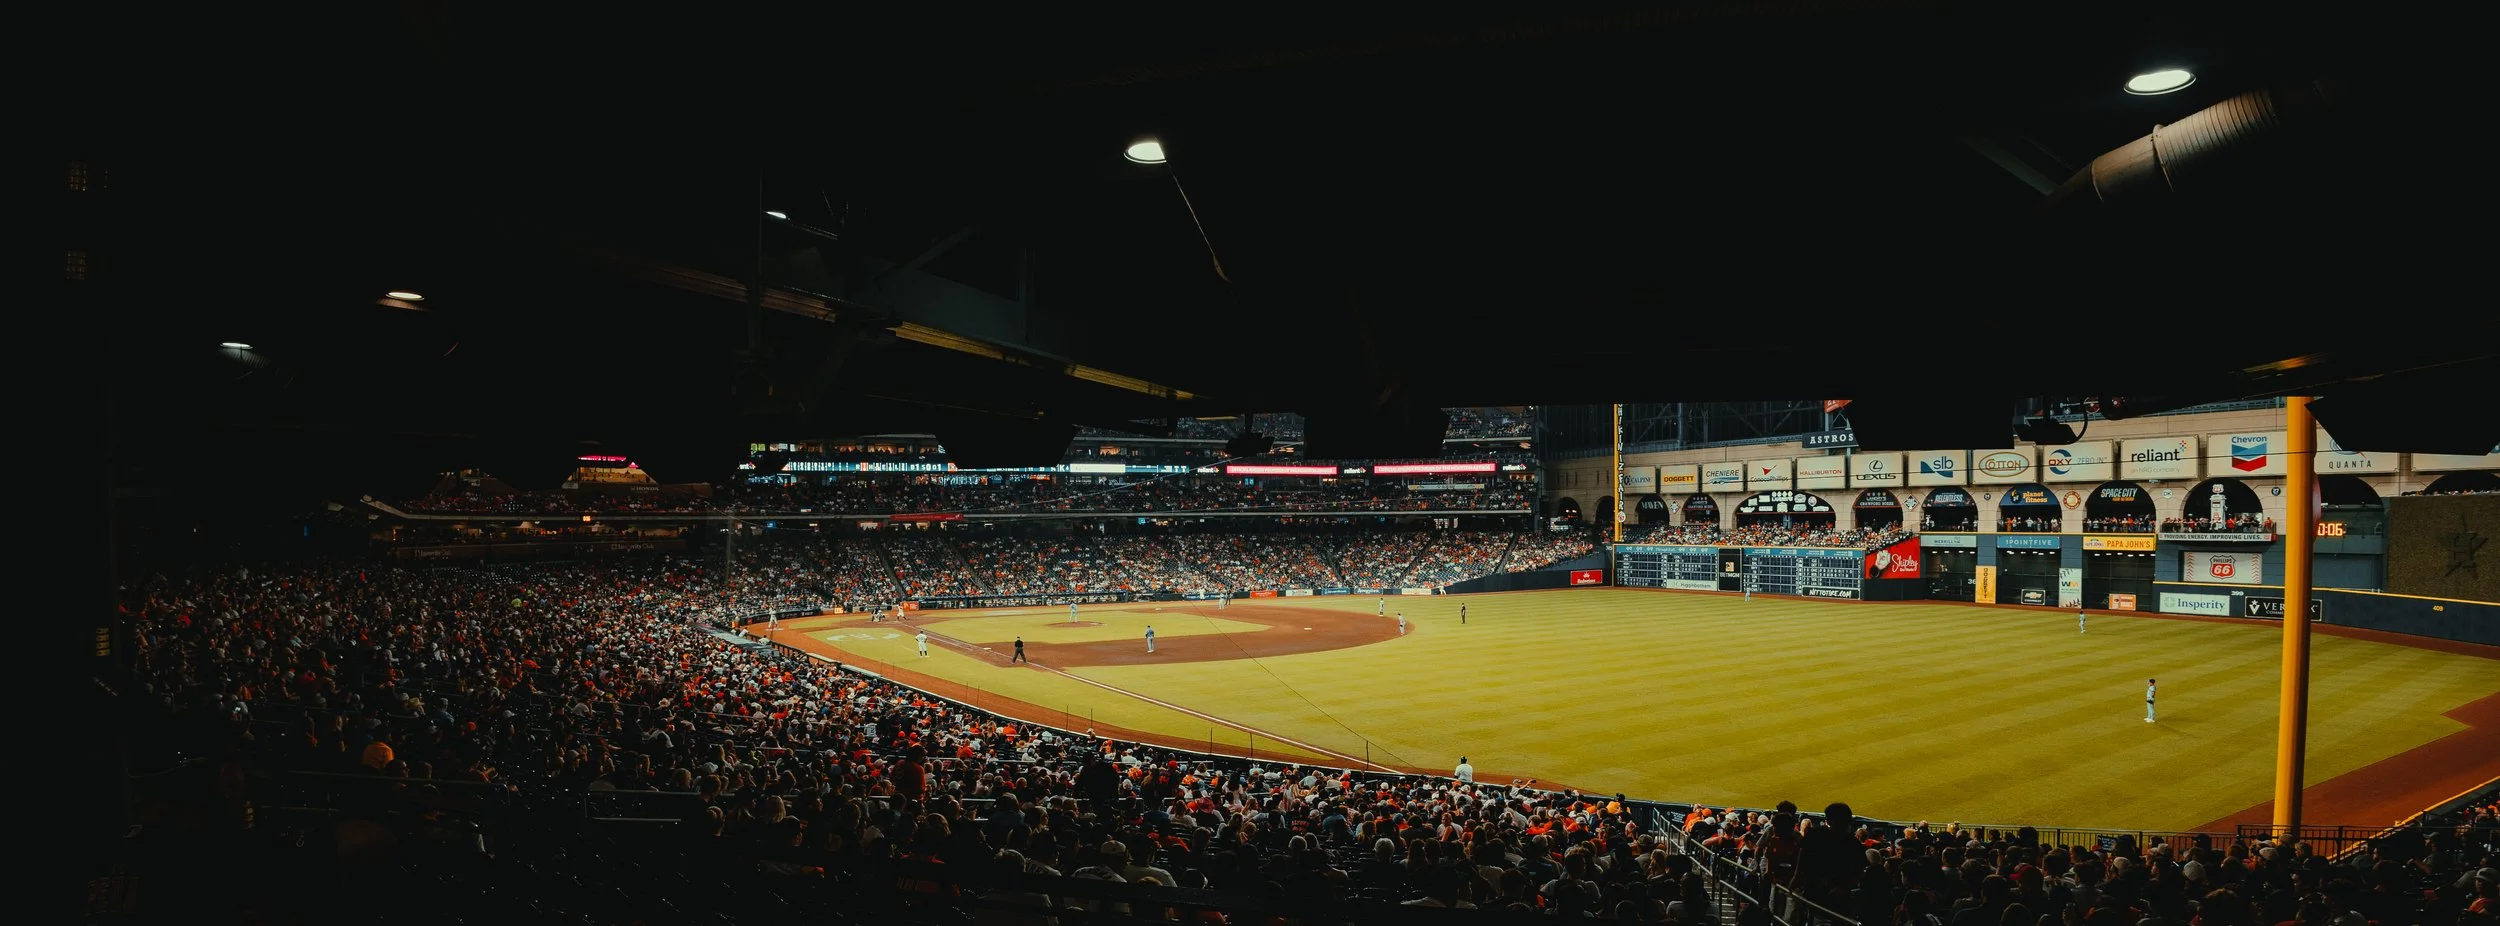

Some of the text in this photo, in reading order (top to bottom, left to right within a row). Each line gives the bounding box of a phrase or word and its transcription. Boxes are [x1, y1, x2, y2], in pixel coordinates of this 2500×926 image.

[1809, 433, 1854, 444] ASTROS
[2231, 435, 2267, 444] Chevron
[2131, 448, 2180, 462] reliant
[1933, 456, 1953, 470] slb
[1985, 458, 2021, 471] COTTON
[2048, 459, 2072, 467] OXY
[2328, 459, 2372, 469] QUANTA
[1705, 469, 1740, 477] CHENIERE
[1663, 475, 1694, 483] DOGGETT
[2101, 488, 2138, 498] SPACE CITY
[1641, 501, 1664, 509] MAVEN
[2106, 540, 2123, 548] PAPA
[2125, 540, 2151, 548] JOHN'S
[1891, 553, 1918, 572] Shipley
[2213, 564, 2231, 574] 66
[2177, 598, 2225, 612] Insperity
